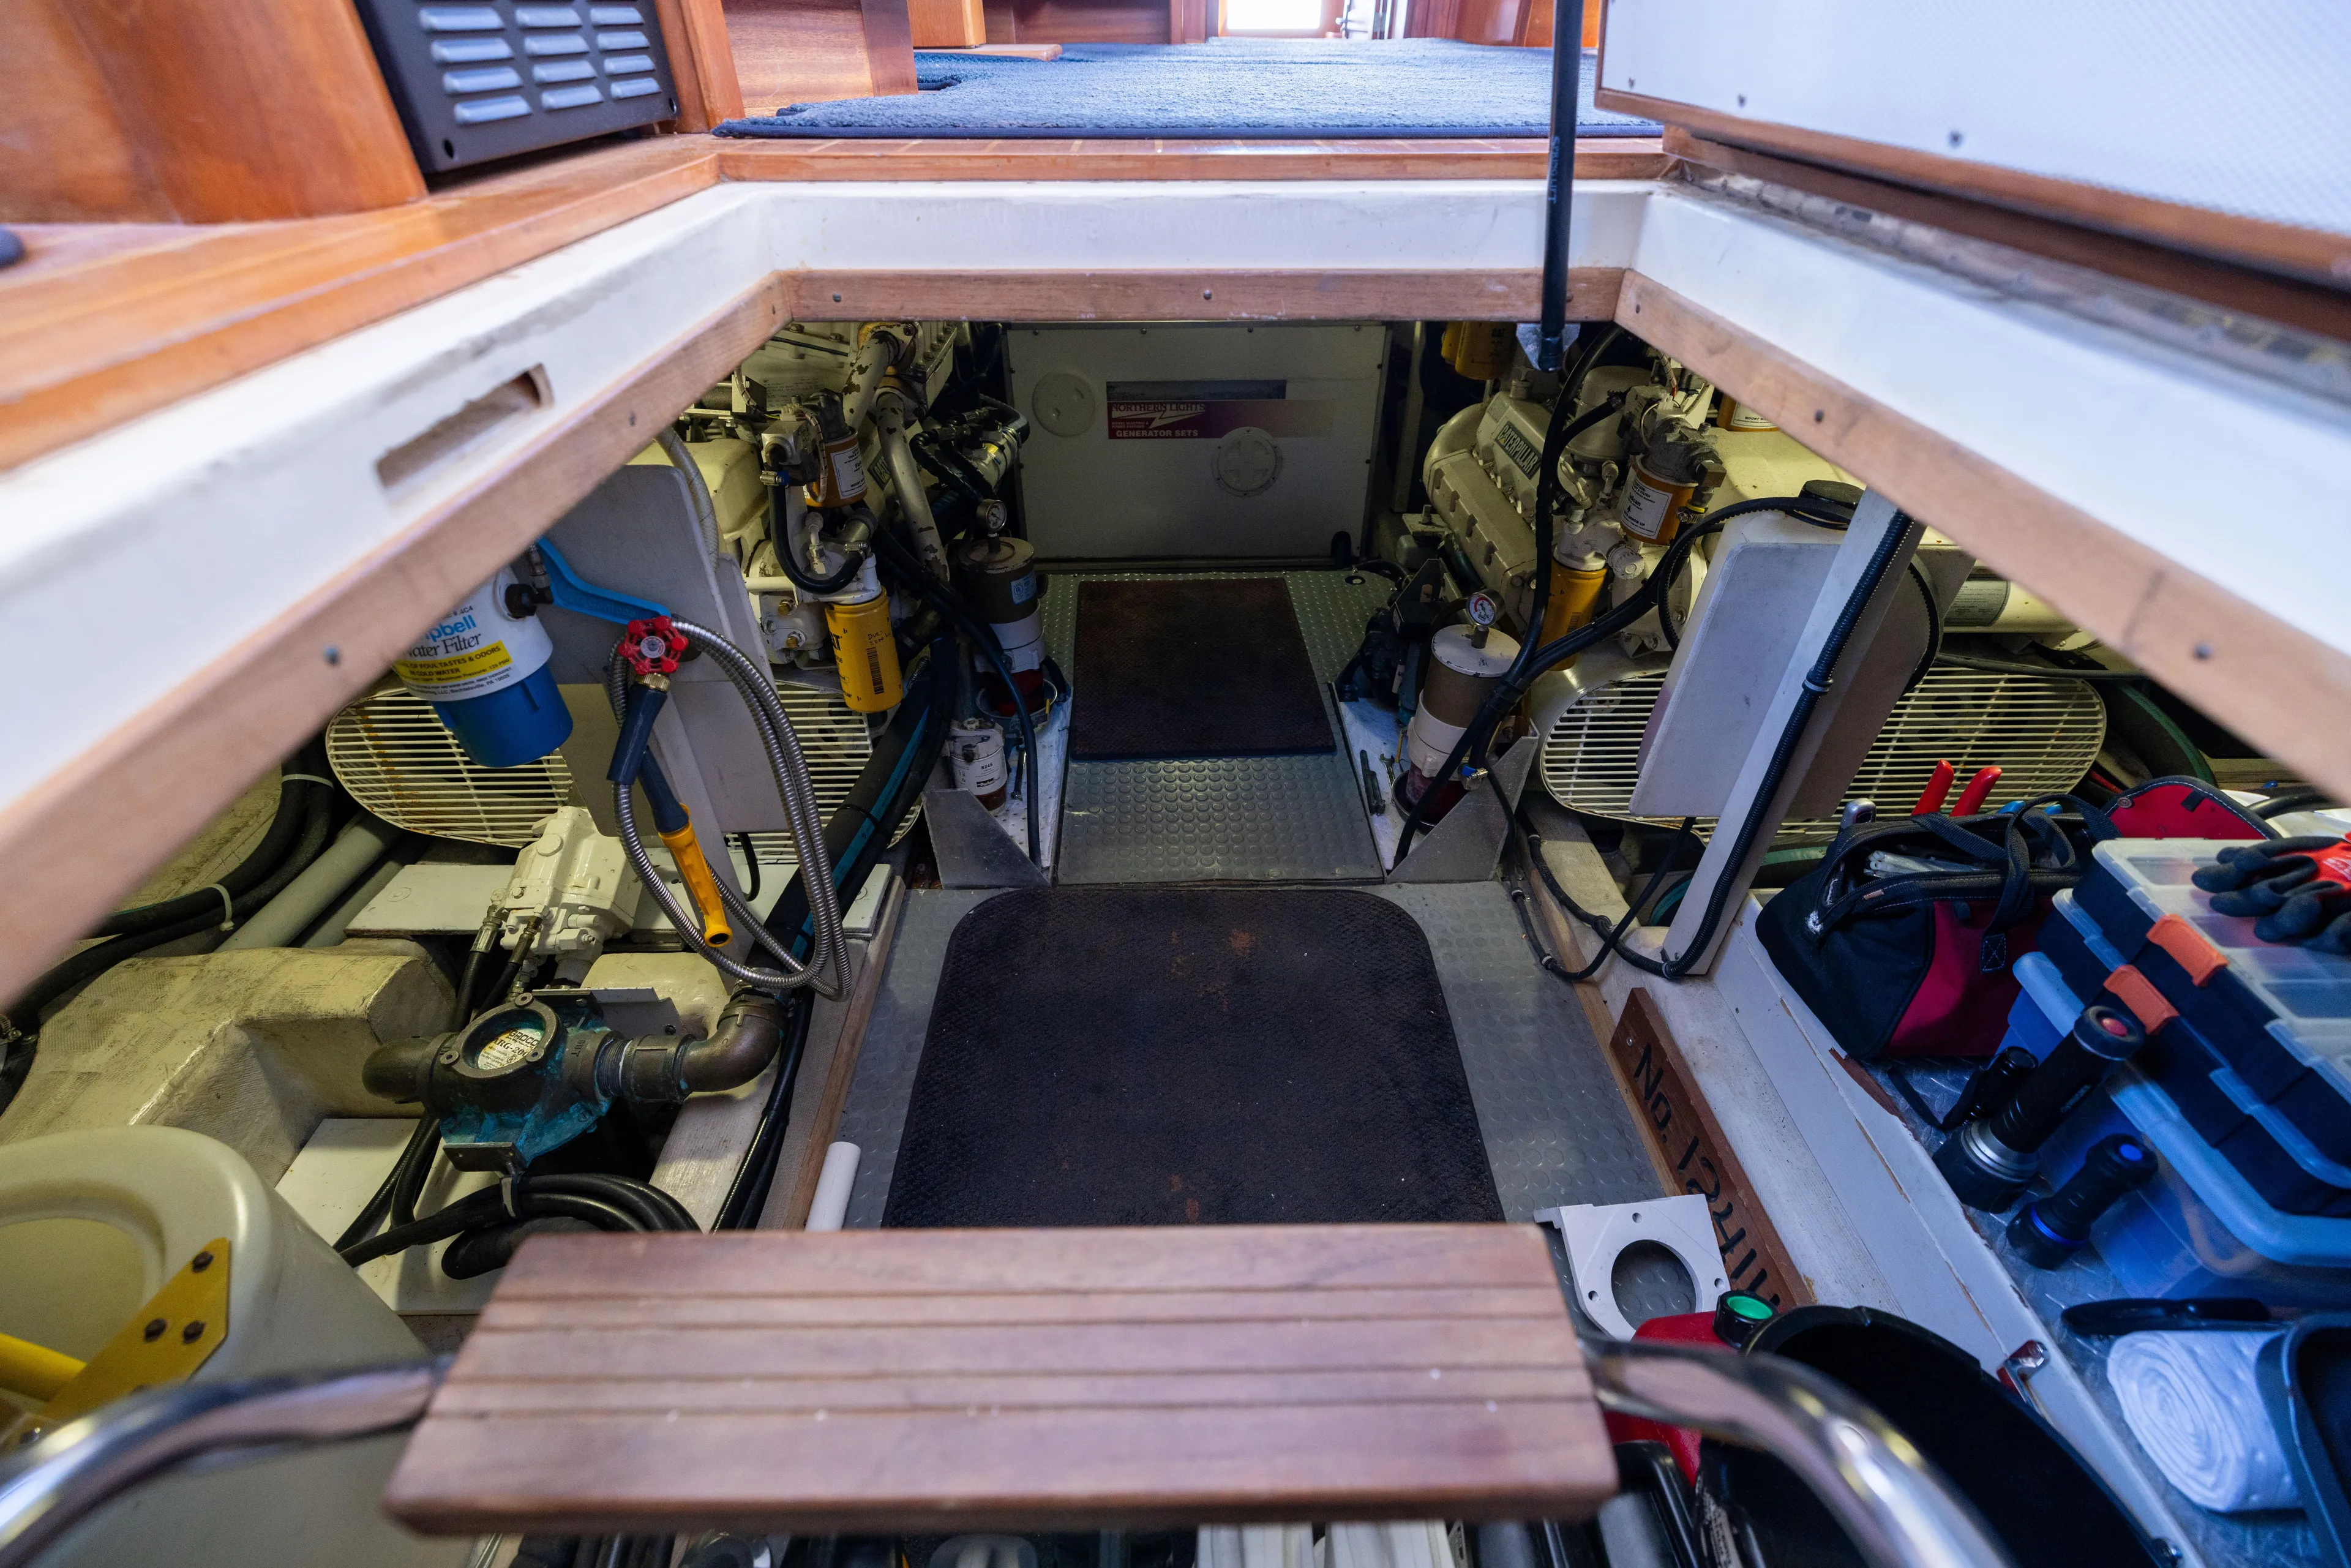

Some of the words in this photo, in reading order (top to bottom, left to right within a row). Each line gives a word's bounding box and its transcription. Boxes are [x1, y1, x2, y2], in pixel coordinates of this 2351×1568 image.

[1497, 424, 1539, 474] CATERPILLAR
[442, 634, 481, 655] Filter
[868, 631, 883, 640] Due:
[438, 657, 467, 668] TASTES
[474, 646, 500, 659] ODORS
[980, 778, 994, 787] Parker
[1633, 1043, 1673, 1143] No.
